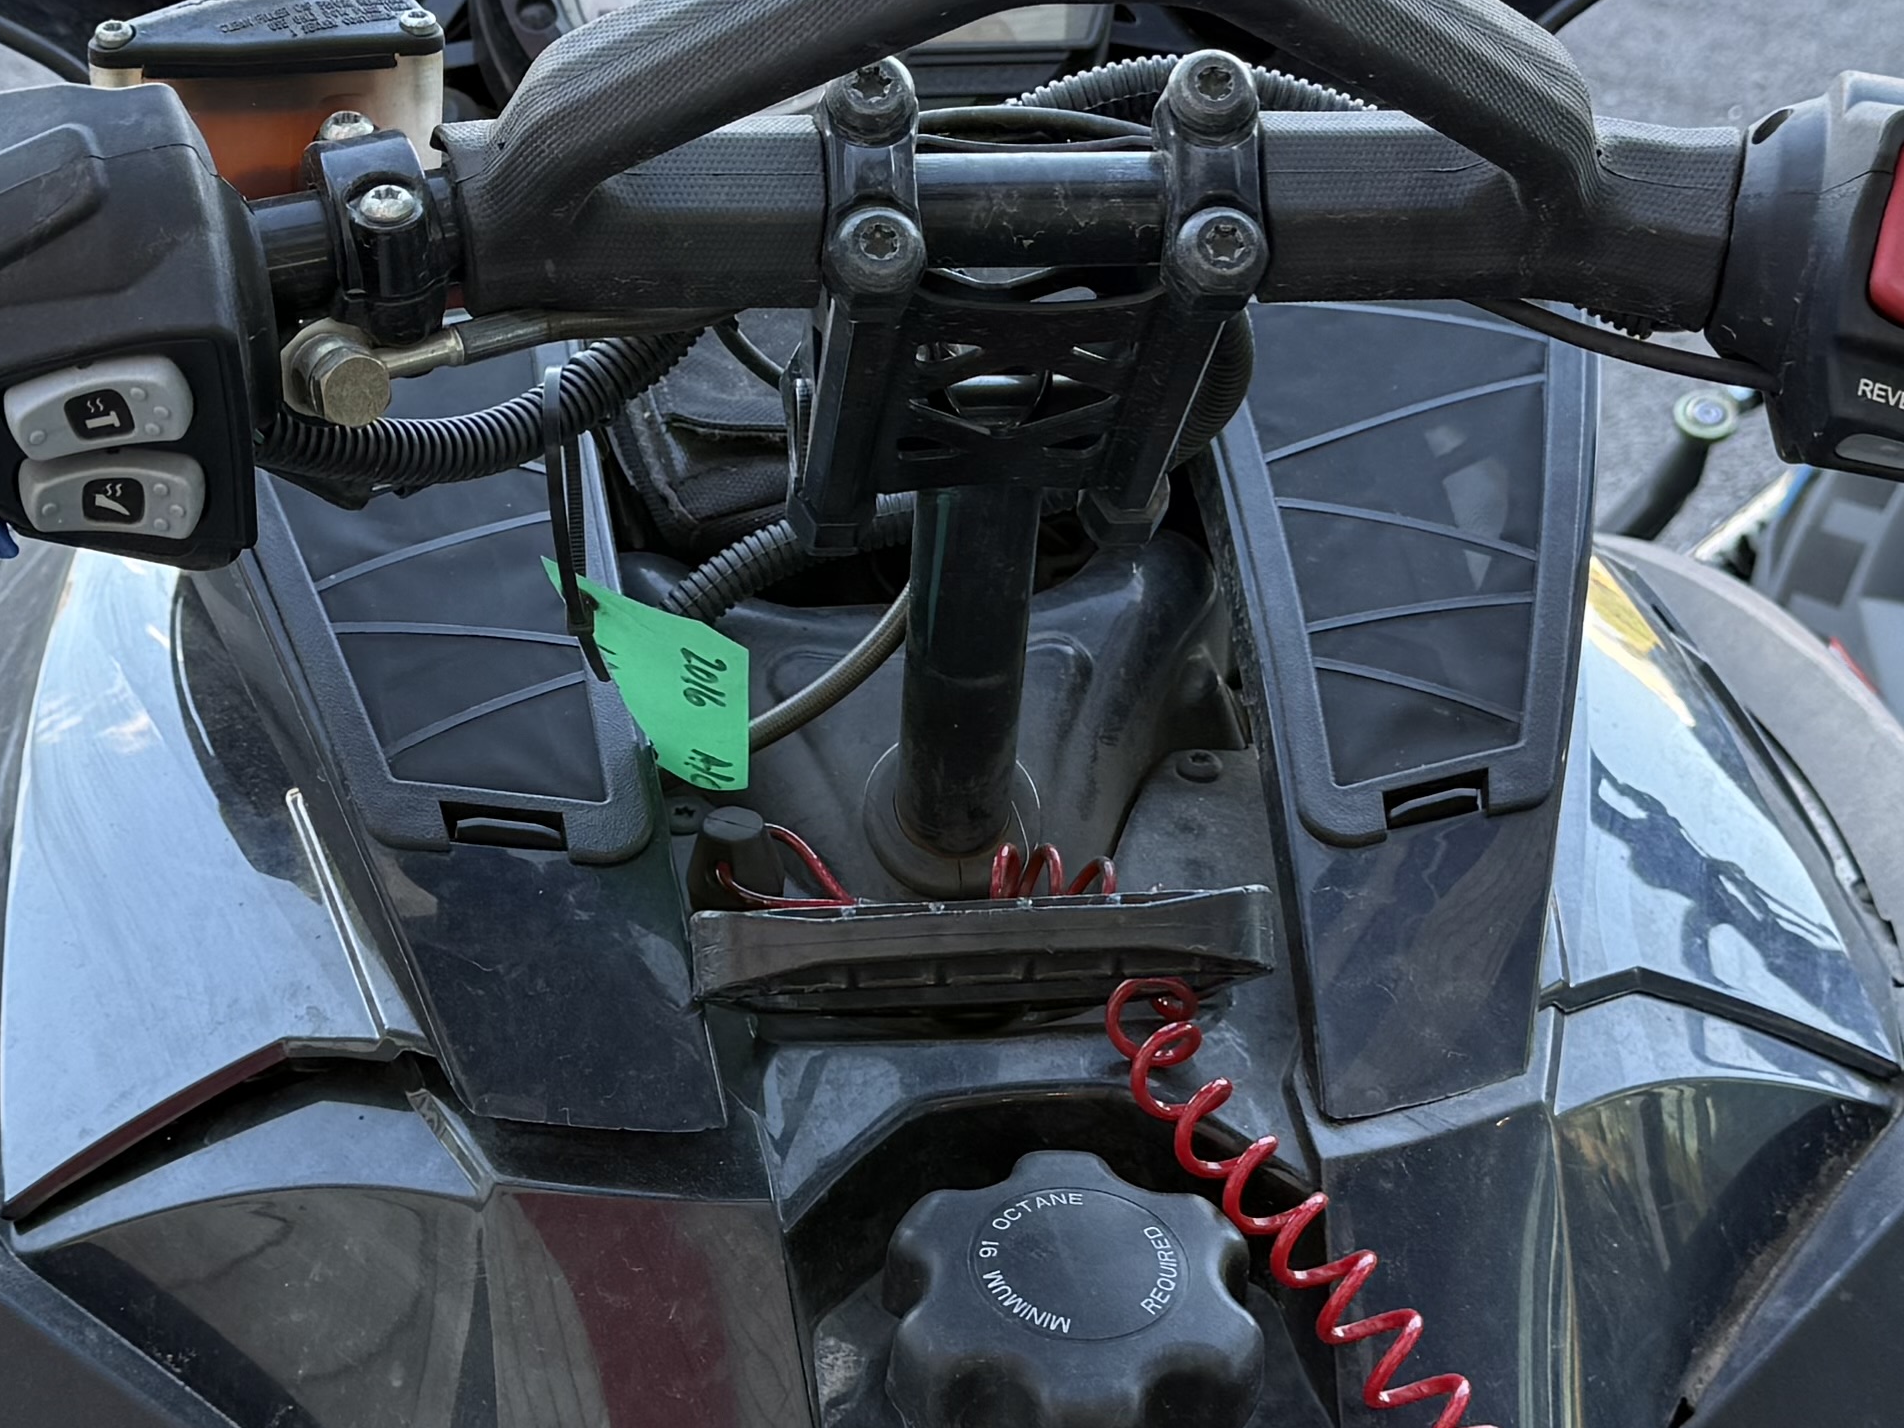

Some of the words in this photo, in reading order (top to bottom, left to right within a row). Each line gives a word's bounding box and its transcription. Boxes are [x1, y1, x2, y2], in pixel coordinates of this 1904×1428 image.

[679, 646, 728, 709] 2016
[992, 1193, 1083, 1230] OCTANE
[979, 1240, 1000, 1258] 91
[1140, 1226, 1178, 1315] REQUIRED
[983, 1270, 1071, 1334] MINIMUM
